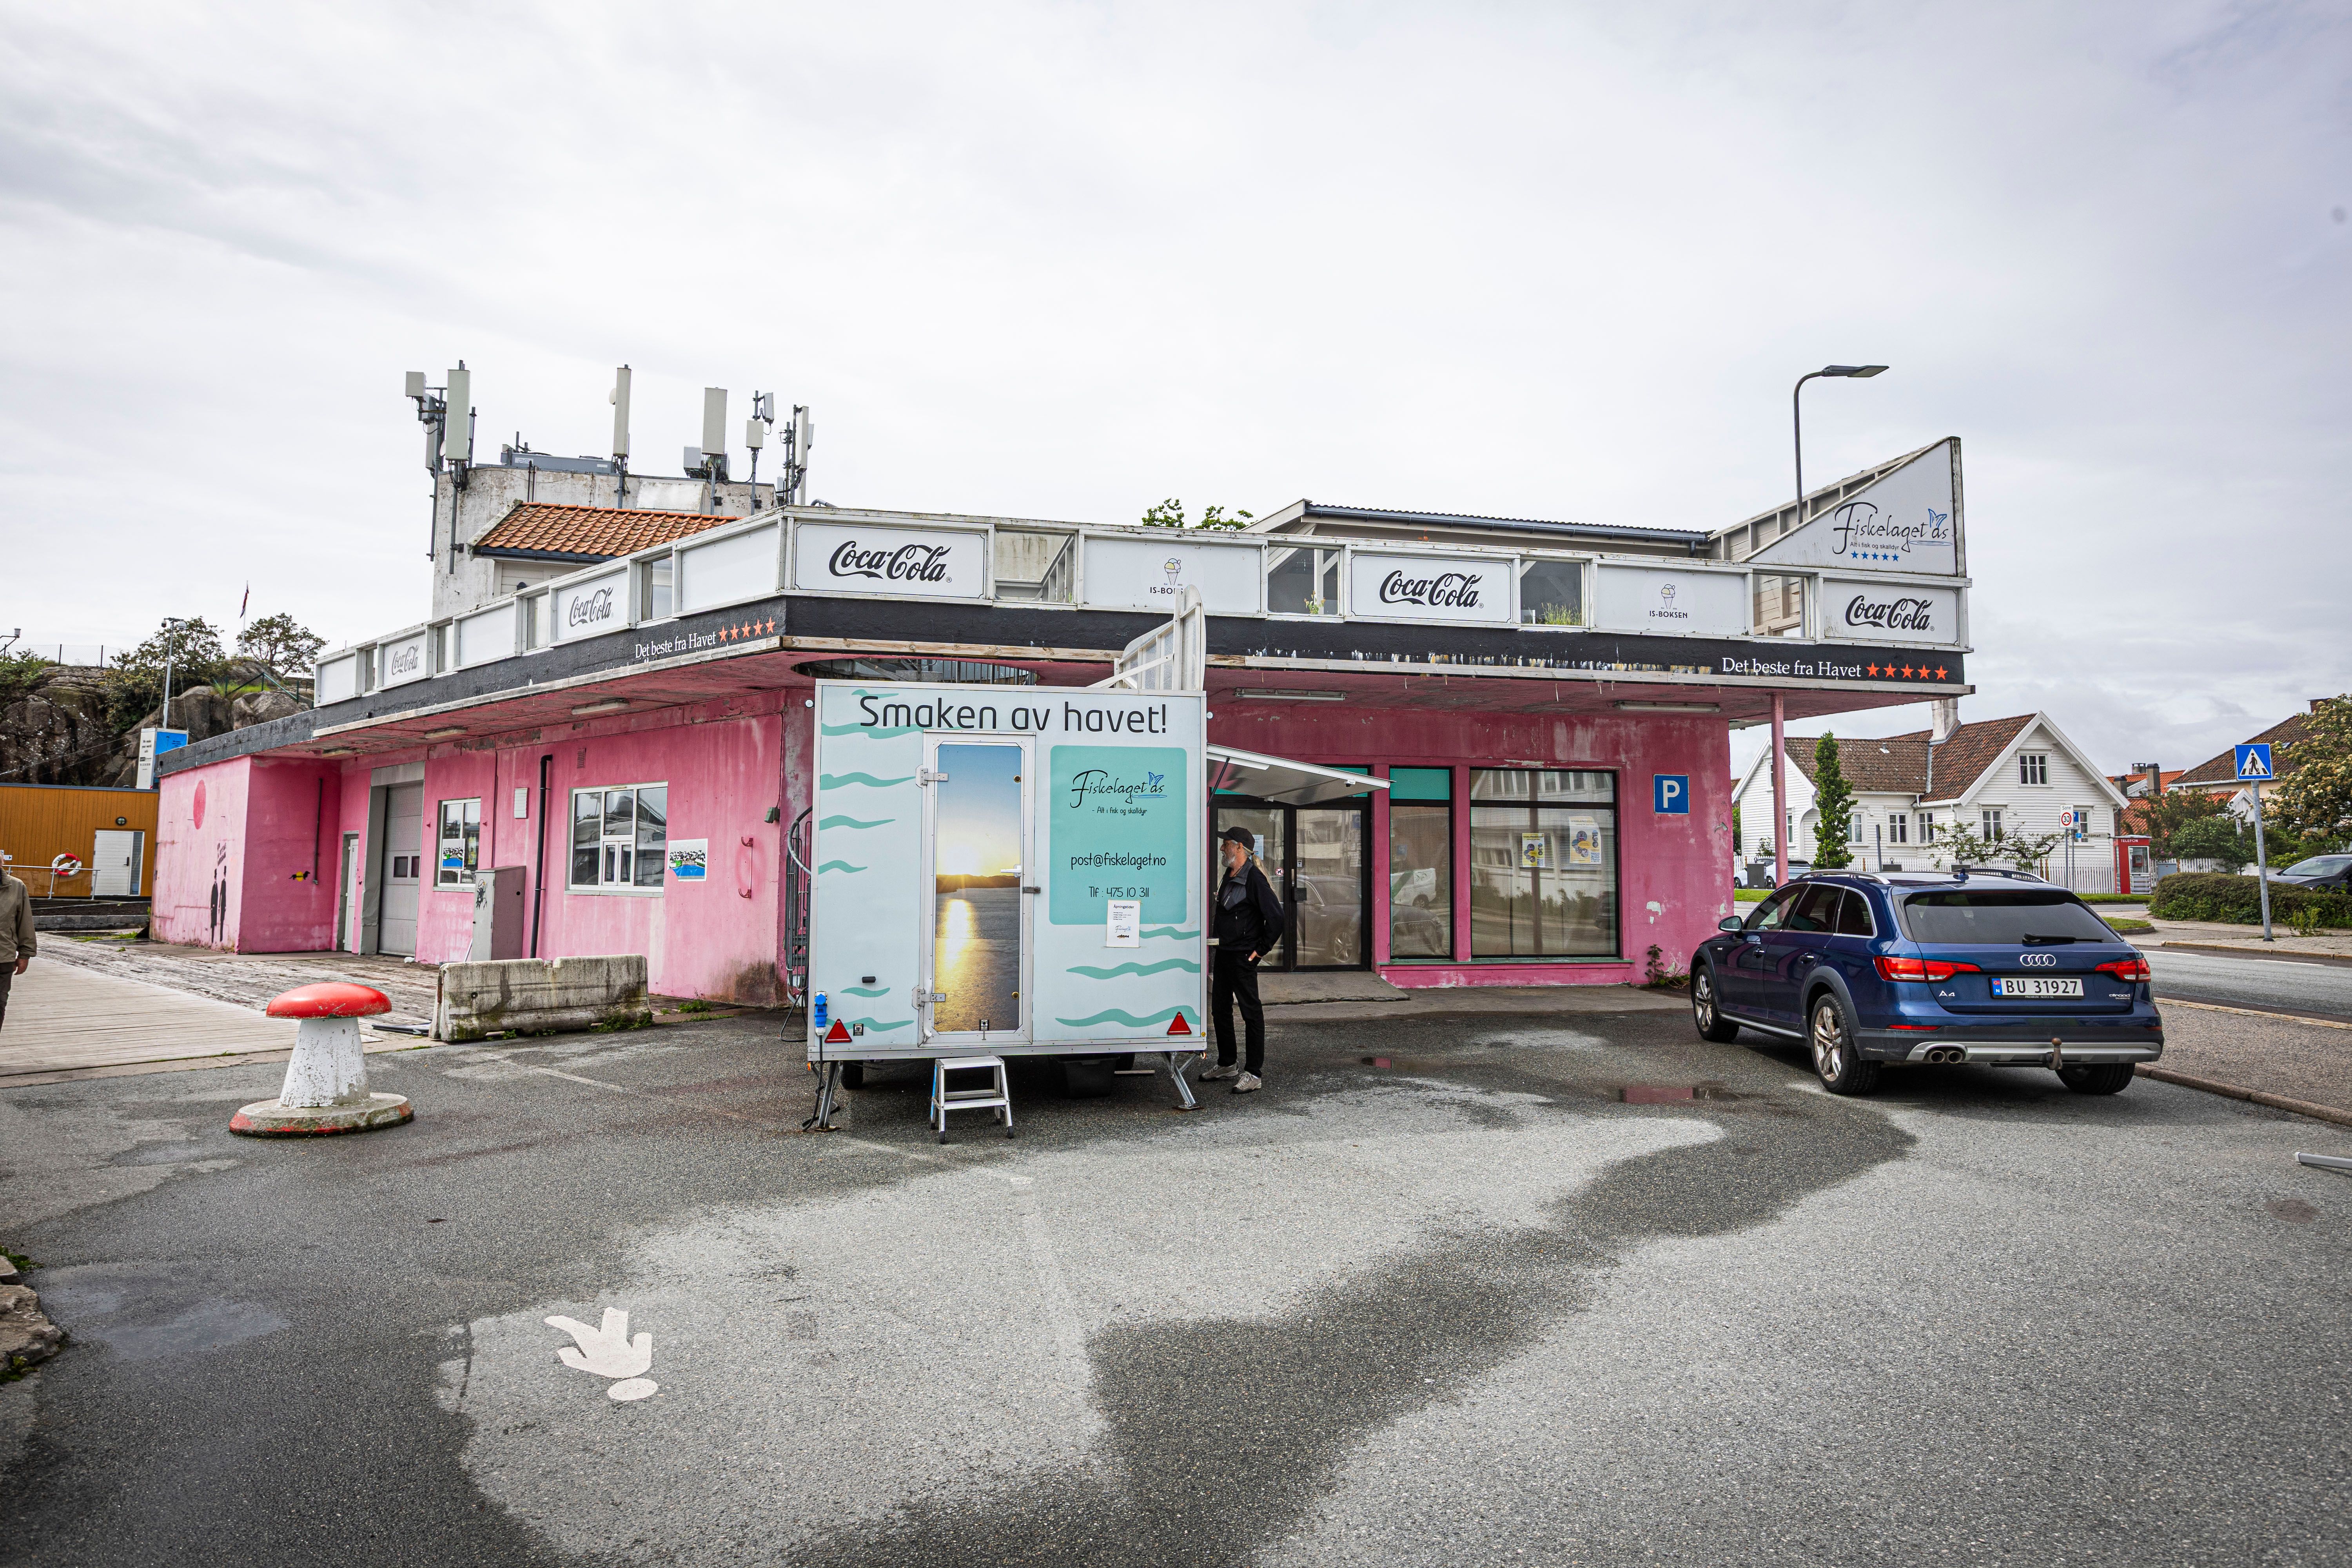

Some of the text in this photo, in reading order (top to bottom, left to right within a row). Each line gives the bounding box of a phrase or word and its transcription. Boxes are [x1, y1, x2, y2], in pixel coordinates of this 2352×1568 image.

[1833, 502, 1929, 554] Fiskelaget
[829, 541, 952, 583] Coca-Cola
[1379, 570, 1483, 608] Coca-Cola
[569, 586, 614, 627] Coca-Cola
[1846, 595, 1933, 632] Coca-Cola
[392, 644, 419, 675] Coca-Cola
[635, 631, 716, 658] Det beste fra Havet
[1722, 657, 1861, 677] Det beste fra Havet
[860, 696, 1167, 733] Smaken av havet!
[1070, 769, 1148, 808] Fiskelaget
[1663, 780, 1681, 808] P
[1128, 808, 1147, 816] skalldyr
[1071, 852, 1166, 870] post@fiskelaget.no
[1106, 887, 1123, 897] 475
[1127, 887, 1136, 897] 10
[1139, 887, 1149, 897] 311
[2005, 980, 2026, 993] BU
[2034, 980, 2078, 994] 31927
